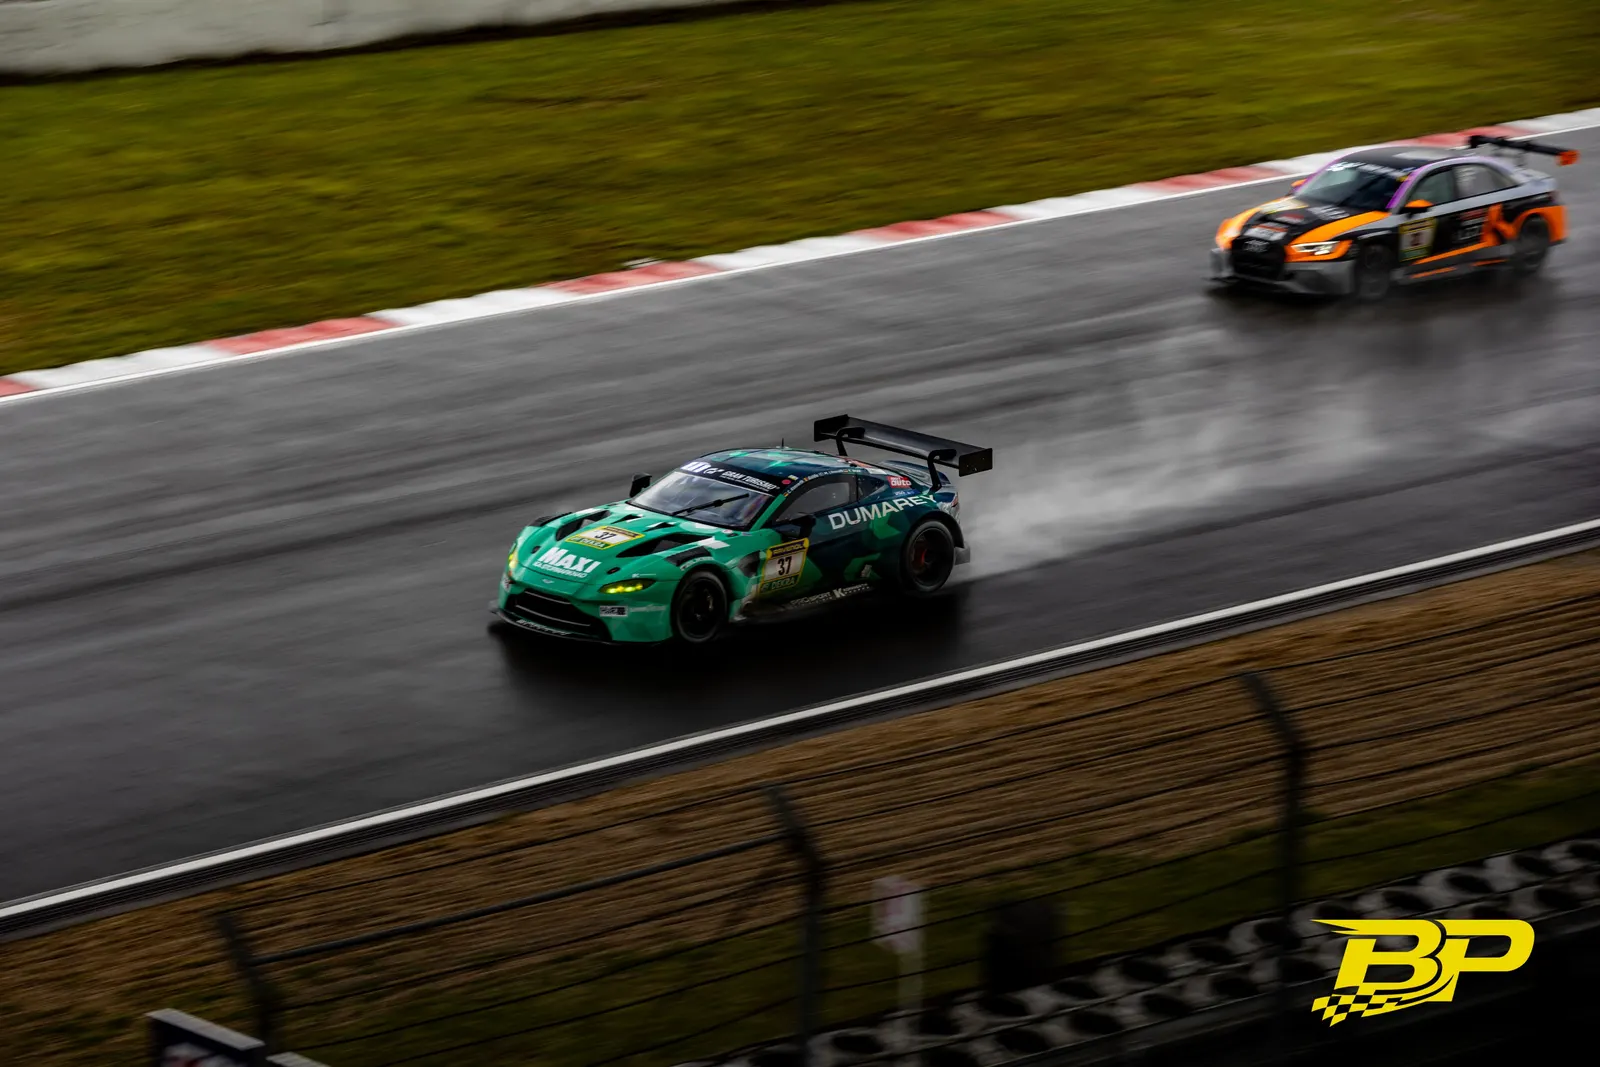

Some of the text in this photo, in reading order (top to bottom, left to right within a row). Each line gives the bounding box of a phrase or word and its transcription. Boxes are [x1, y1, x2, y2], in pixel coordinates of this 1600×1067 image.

[890, 479, 912, 487] auto
[828, 494, 937, 530] DUMAREY
[594, 531, 617, 541] 37
[537, 546, 602, 574] MAXI
[777, 556, 792, 576] 37
